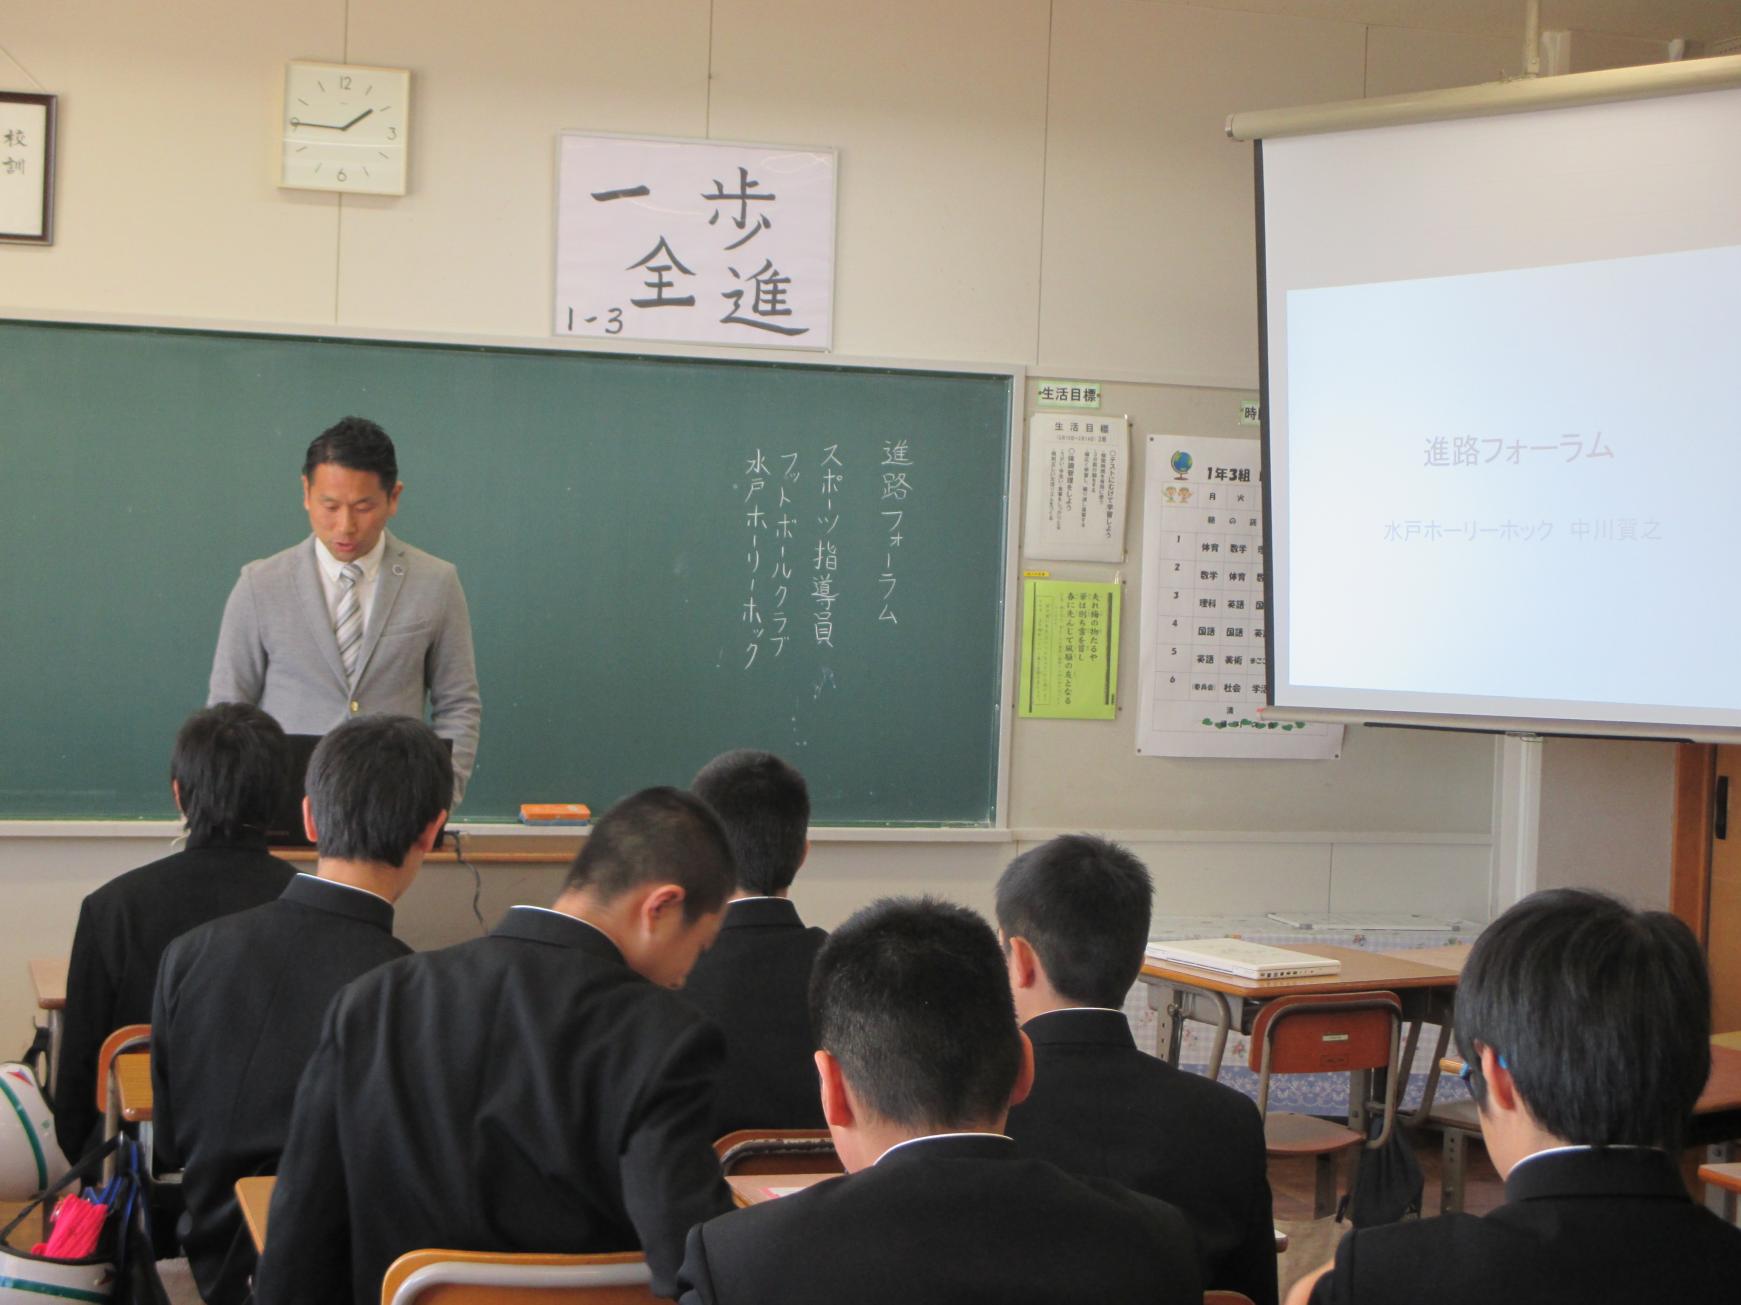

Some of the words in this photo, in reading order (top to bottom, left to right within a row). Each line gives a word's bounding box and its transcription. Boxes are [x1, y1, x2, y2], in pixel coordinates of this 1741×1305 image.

[340, 75, 353, 91] 12
[387, 126, 398, 141] 3
[3, 128, 28, 175] 校訓
[336, 168, 348, 182] 6
[567, 307, 623, 334] 1-3
[1041, 386, 1096, 402] 生活目標
[1244, 406, 1260, 421] 時
[1423, 431, 1615, 467] 進路フォーラム
[1207, 467, 1250, 482] 1年3組
[1209, 492, 1216, 501] 月
[1237, 494, 1245, 502] 火
[878, 439, 914, 626] 進路フォーラム
[1383, 519, 1555, 542] 水戸ホーリーホック
[810, 444, 844, 648] スポーツ指導員
[1176, 535, 1181, 543] 1
[1201, 543, 1219, 552] 体育
[1230, 543, 1247, 553] 数学
[742, 448, 771, 670] 水戸ホーリーホック
[769, 452, 800, 657] フットボールクラブ
[1174, 563, 1180, 571] 2
[1200, 571, 1218, 580] 数学
[1229, 572, 1246, 582] 体育
[1173, 591, 1179, 599] 3
[1199, 599, 1216, 608] 理科
[1227, 600, 1244, 609] 英語
[1171, 619, 1178, 627] 4
[1198, 627, 1215, 636] 国語
[1226, 628, 1243, 637] 国語
[1171, 647, 1177, 655] 5
[1197, 655, 1214, 664] 英語
[1169, 676, 1175, 684] 6
[1224, 683, 1241, 693] 社会
